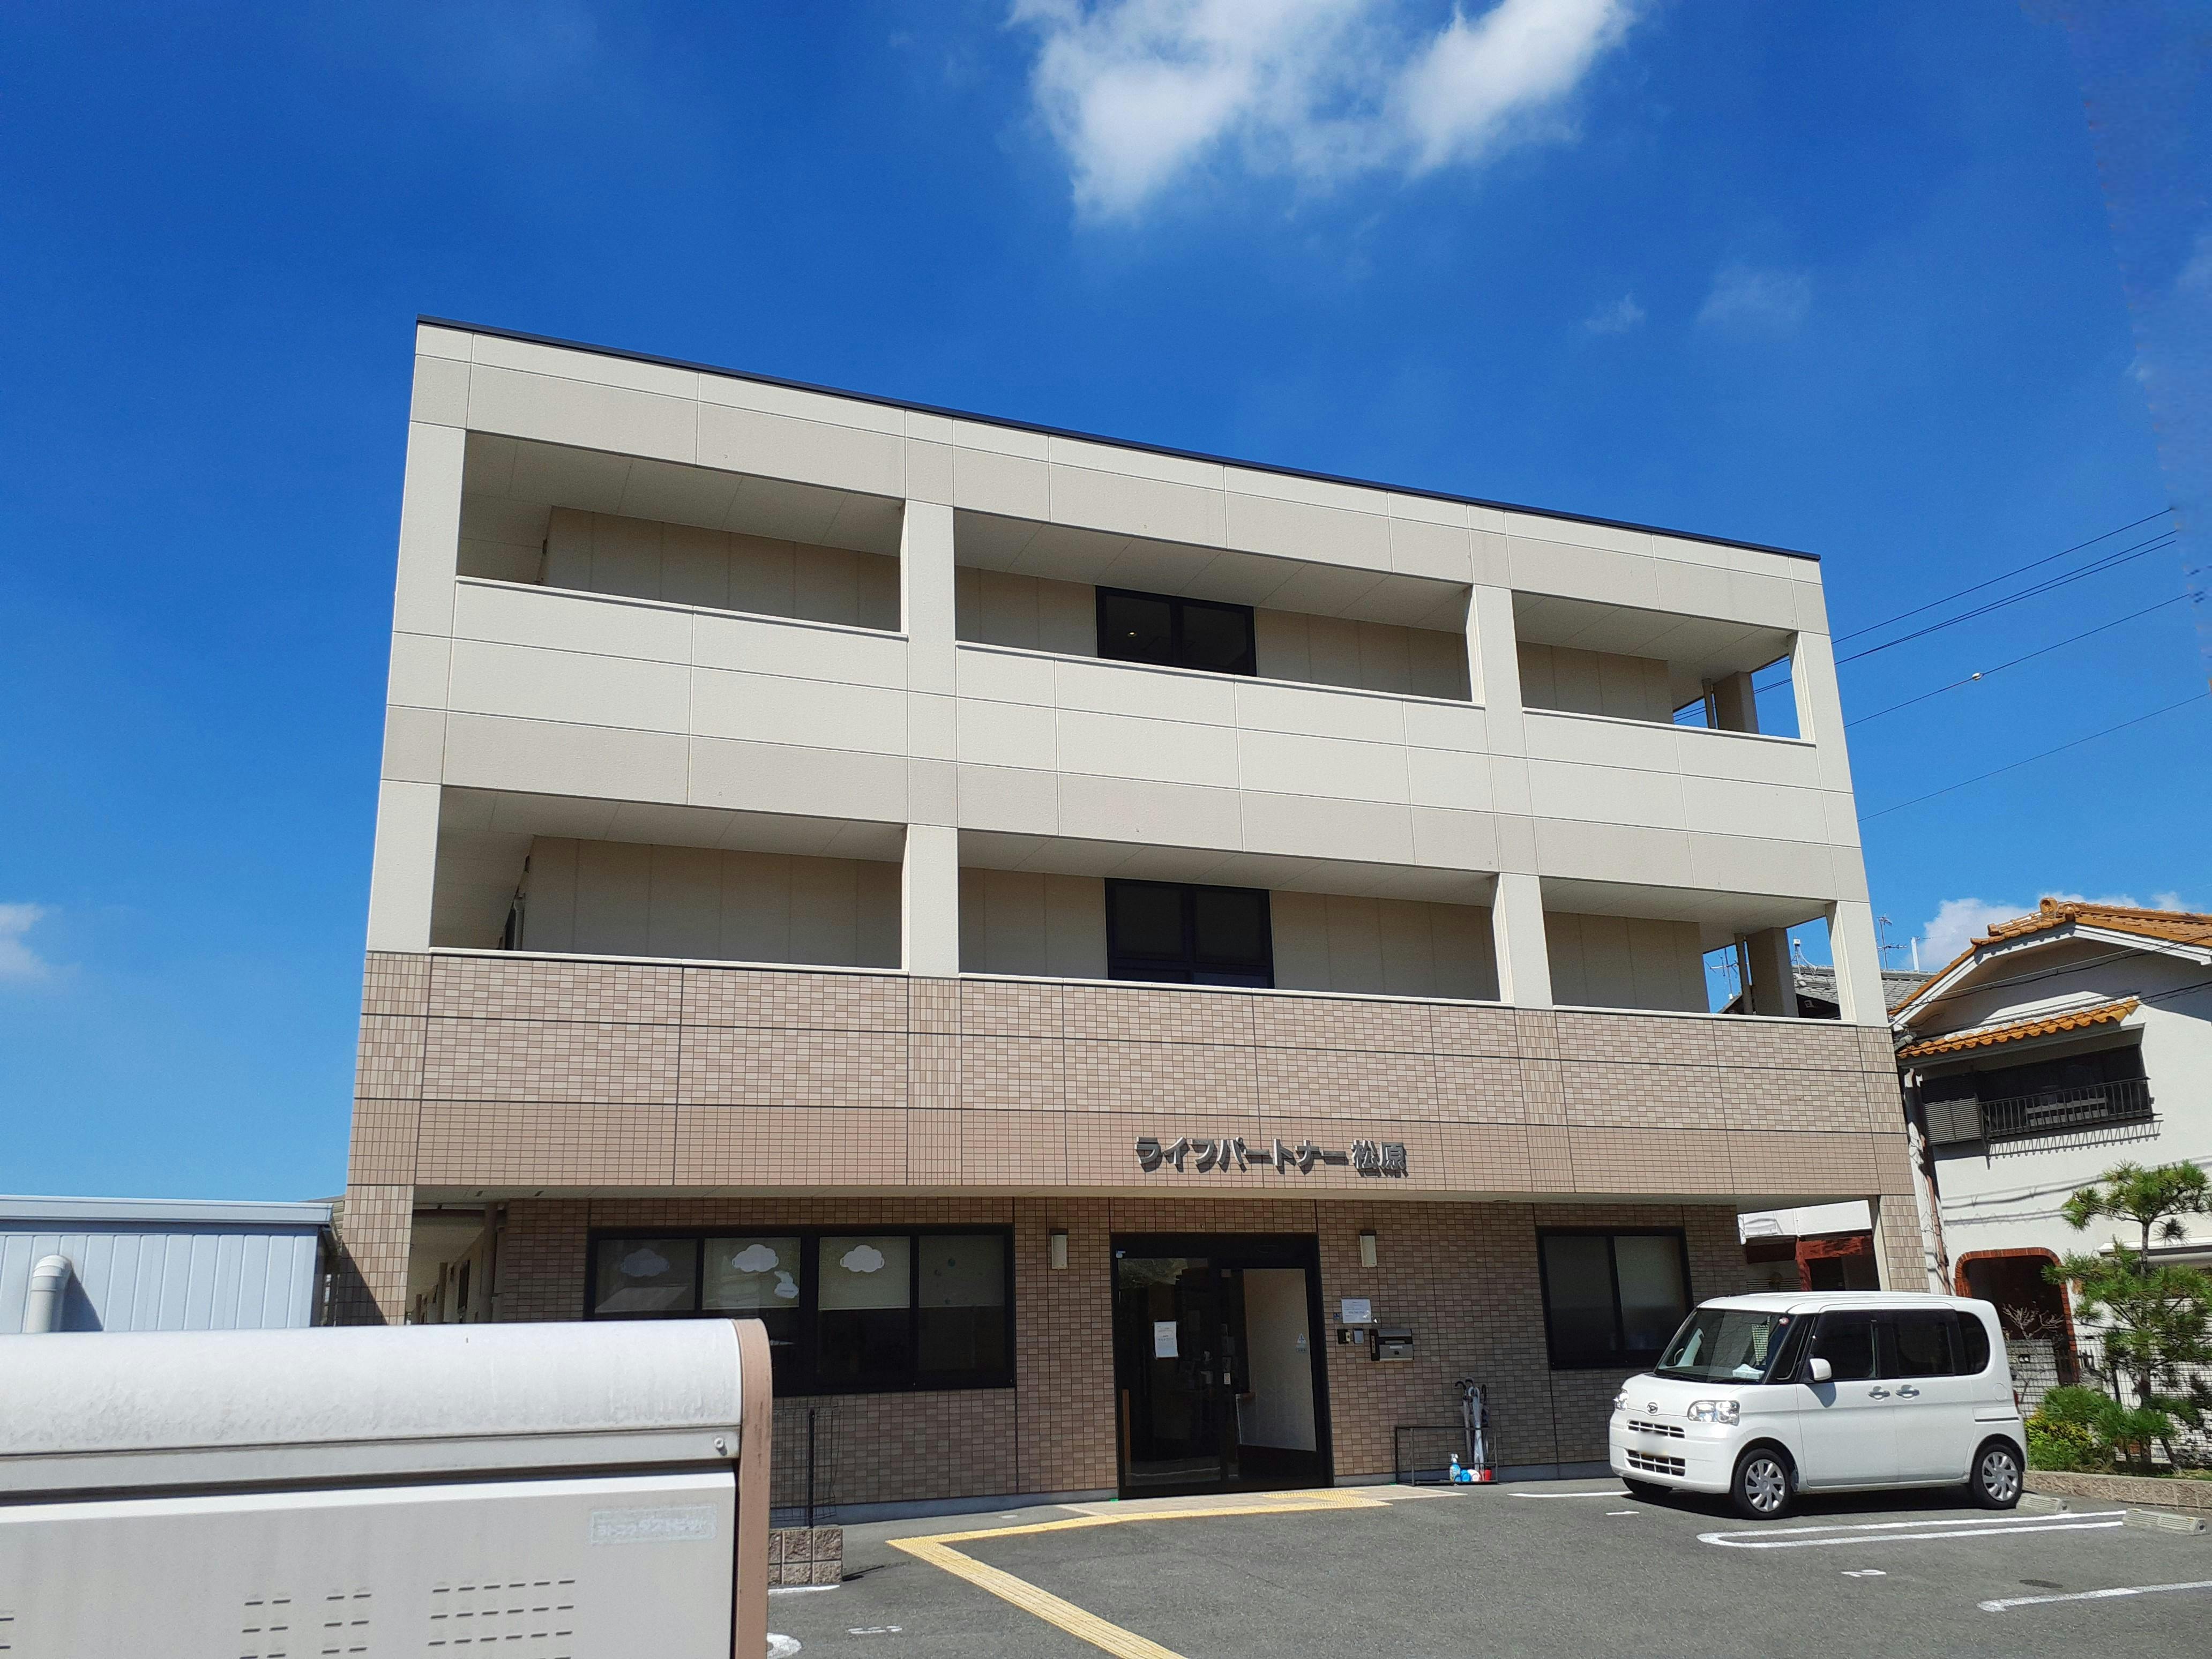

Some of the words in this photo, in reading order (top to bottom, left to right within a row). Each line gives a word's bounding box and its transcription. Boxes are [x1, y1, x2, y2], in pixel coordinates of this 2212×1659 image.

[1134, 1136, 1404, 1171] ライフパートナー松原
